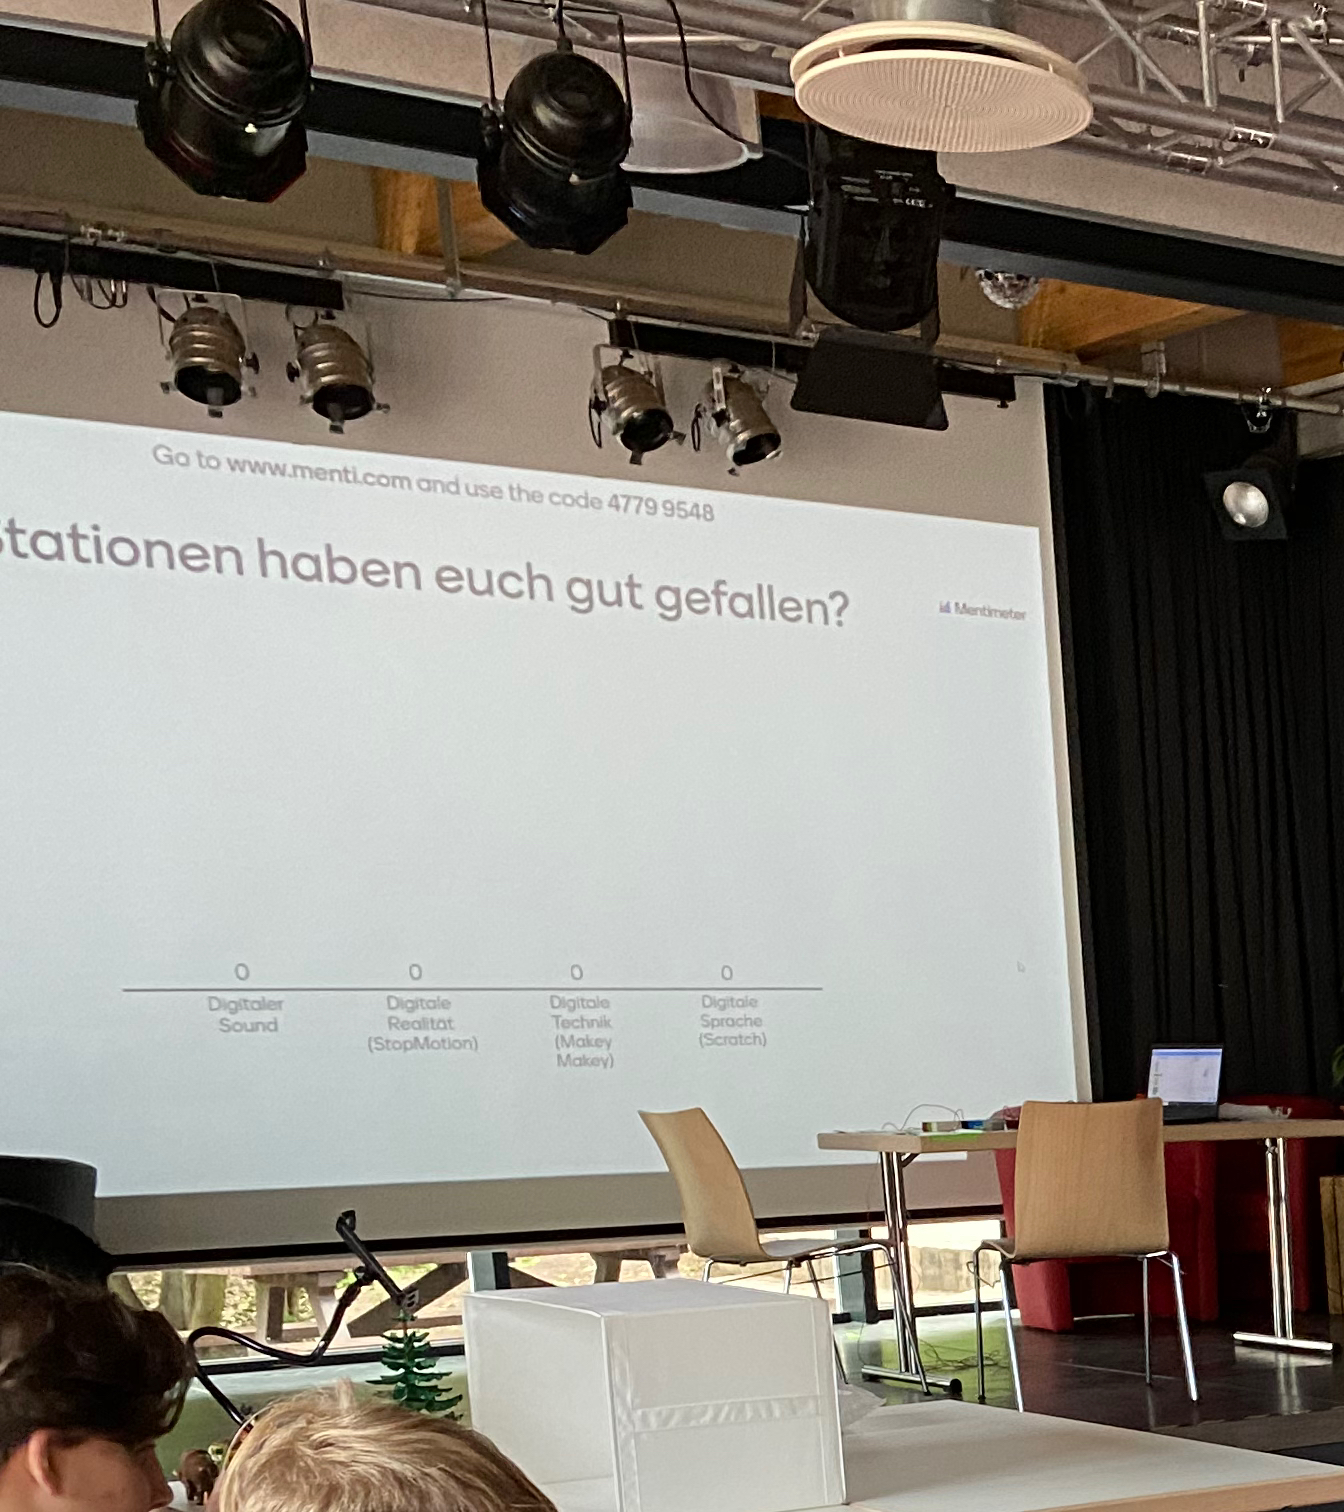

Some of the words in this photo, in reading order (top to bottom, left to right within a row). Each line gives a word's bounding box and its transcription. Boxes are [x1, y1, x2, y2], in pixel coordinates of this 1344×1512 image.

[153, 444, 190, 468] Go
[196, 449, 222, 470] to
[227, 455, 413, 491] www.menti.com
[416, 474, 461, 497] and
[463, 483, 504, 500] use
[508, 483, 544, 504] the
[549, 489, 603, 511] code
[607, 493, 658, 516] 4779
[662, 499, 716, 523] 9548
[257, 536, 423, 592] haben
[434, 561, 555, 603] euch
[565, 572, 645, 615] gut
[655, 579, 851, 628] gefallen?
[207, 995, 285, 1015] Digitaler
[386, 994, 452, 1014] Digitale
[550, 994, 611, 1012] Digitale
[701, 994, 759, 1012] Digitale
[218, 1017, 279, 1033] Sound
[551, 1014, 613, 1031] Technik
[700, 1013, 763, 1031] Sprache
[367, 1034, 479, 1054] (StopMotion)
[555, 1033, 613, 1051] (Makey
[699, 1031, 768, 1049] (Scratch)
[556, 1052, 615, 1069] Makey)
